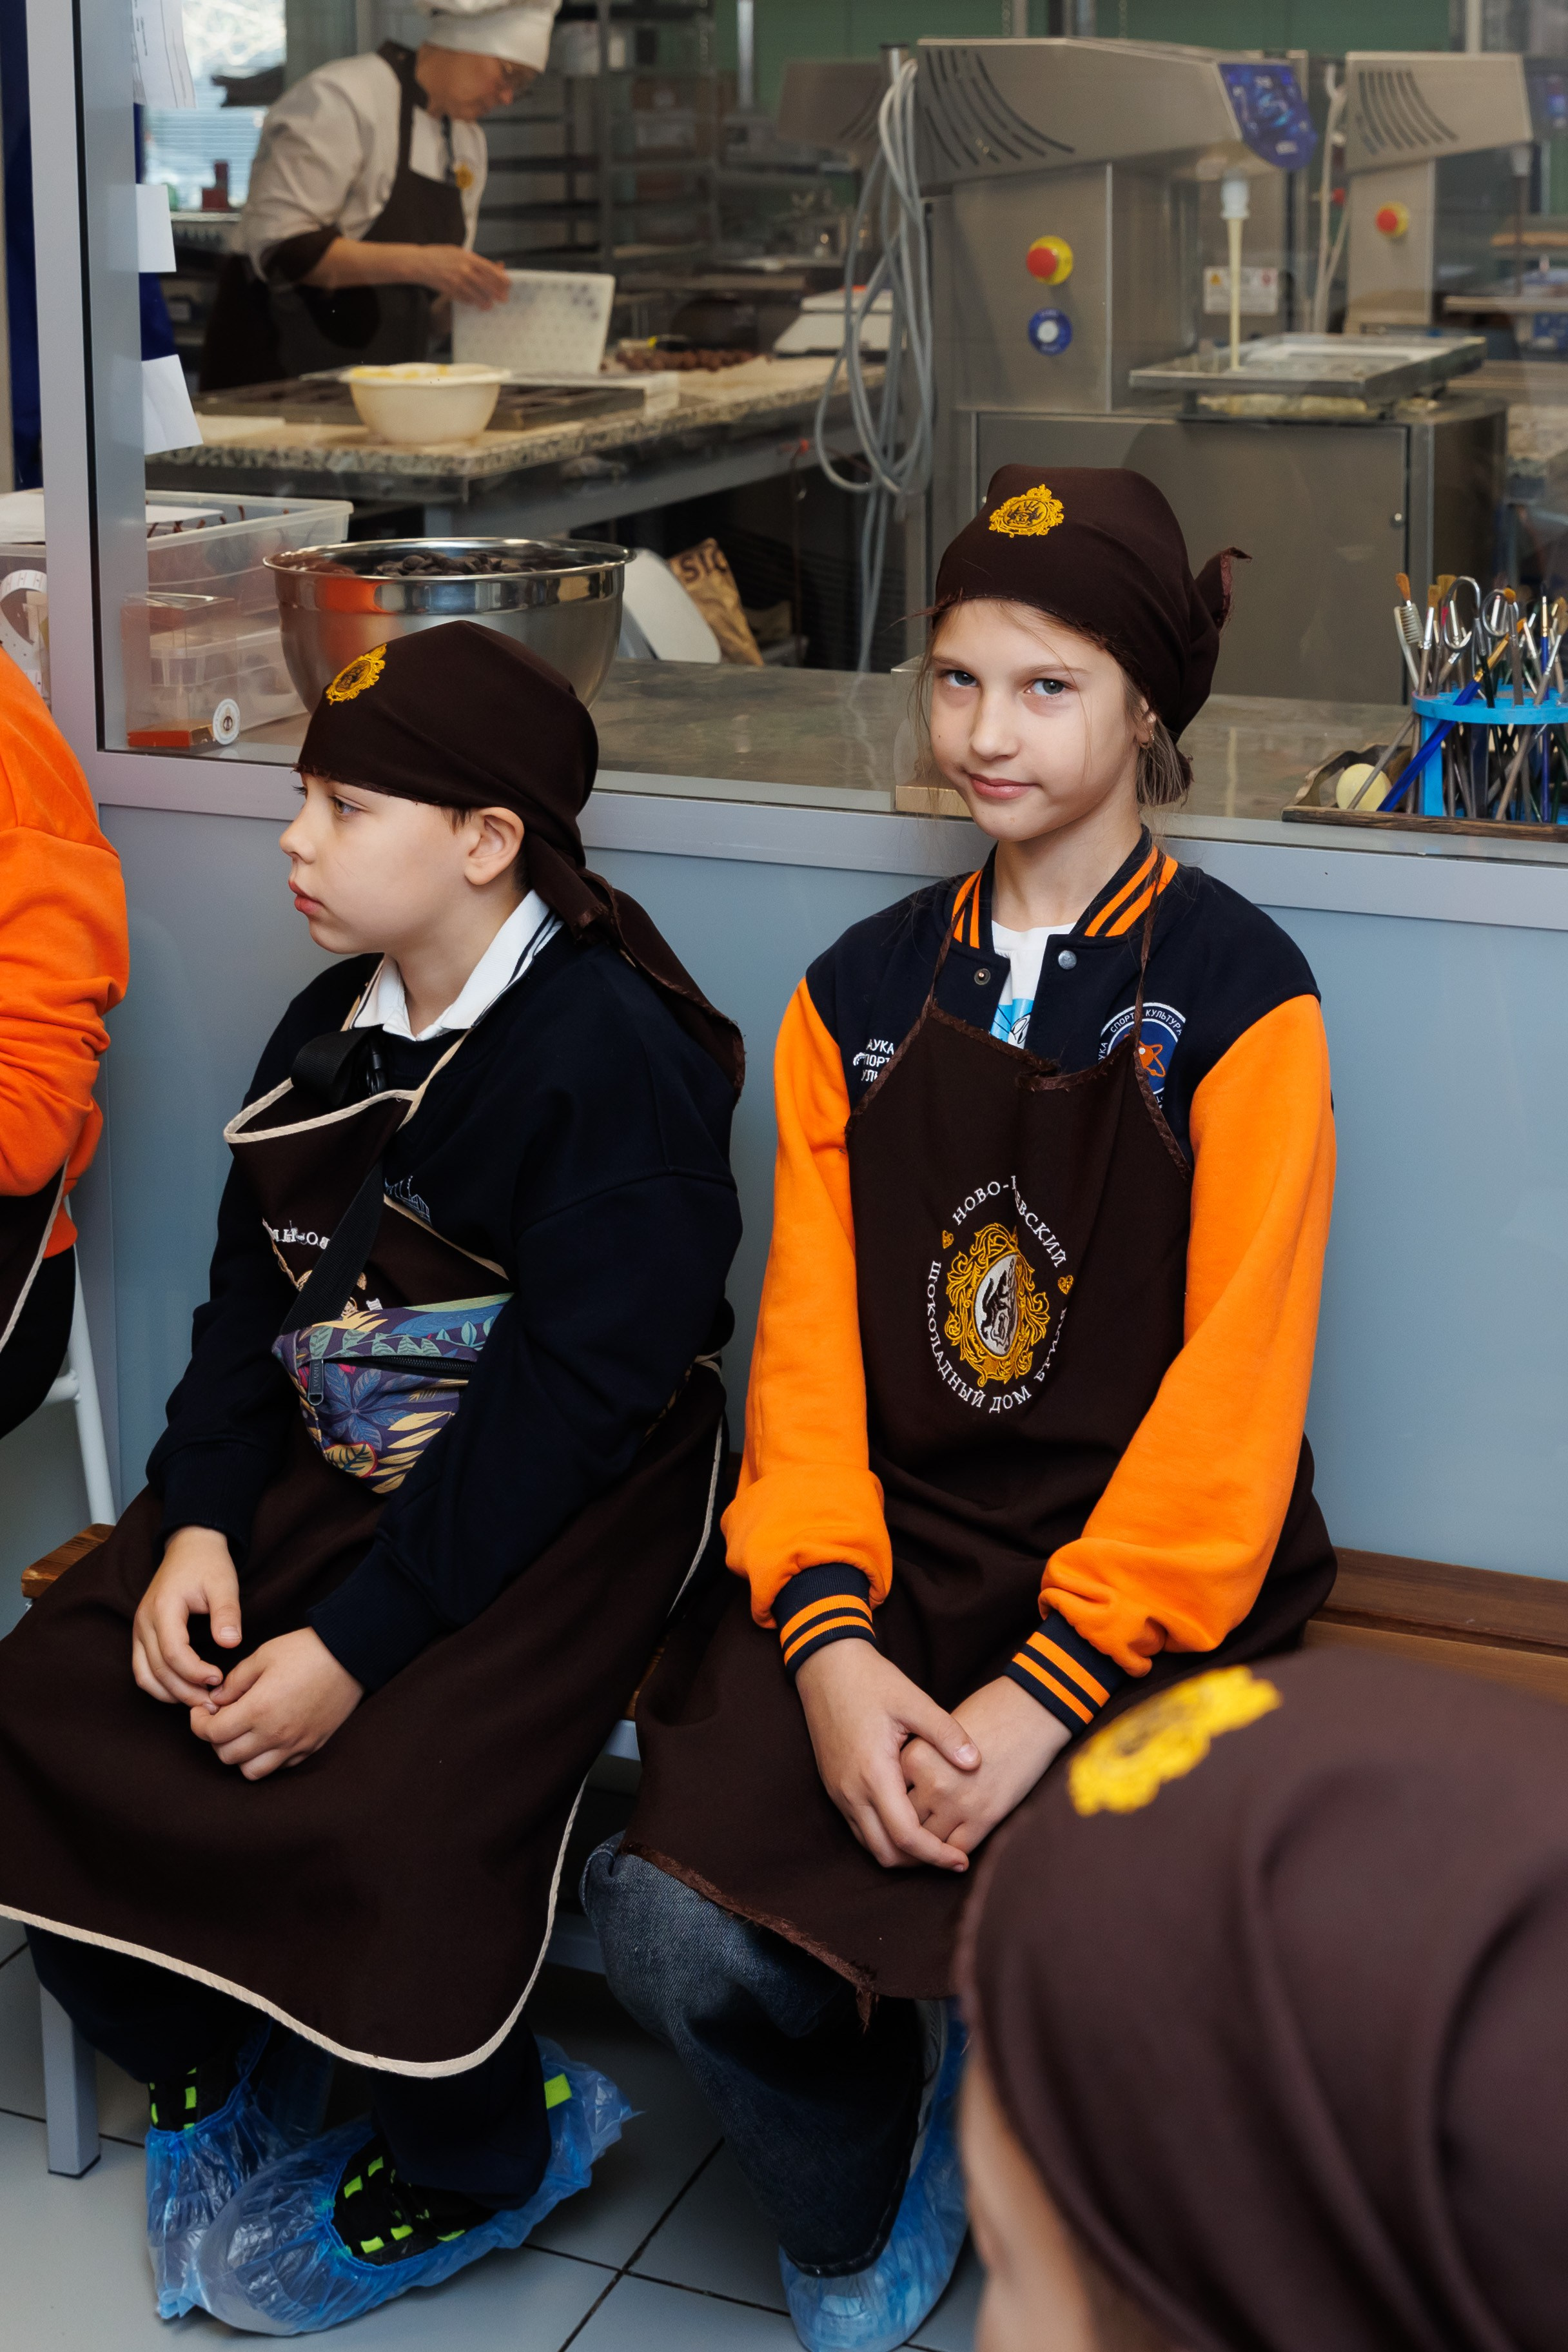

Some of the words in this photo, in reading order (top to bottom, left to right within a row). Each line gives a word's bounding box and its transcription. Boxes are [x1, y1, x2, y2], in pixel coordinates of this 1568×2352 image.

[866, 1039, 894, 1055] АУКА
[1098, 1043, 1109, 1061] УКА
[1110, 1012, 1135, 1033] СПОРТ
[927, 1260, 986, 1408] ШОКОЛАДНЫЙ
[988, 1385, 1032, 1414] ДОМ
